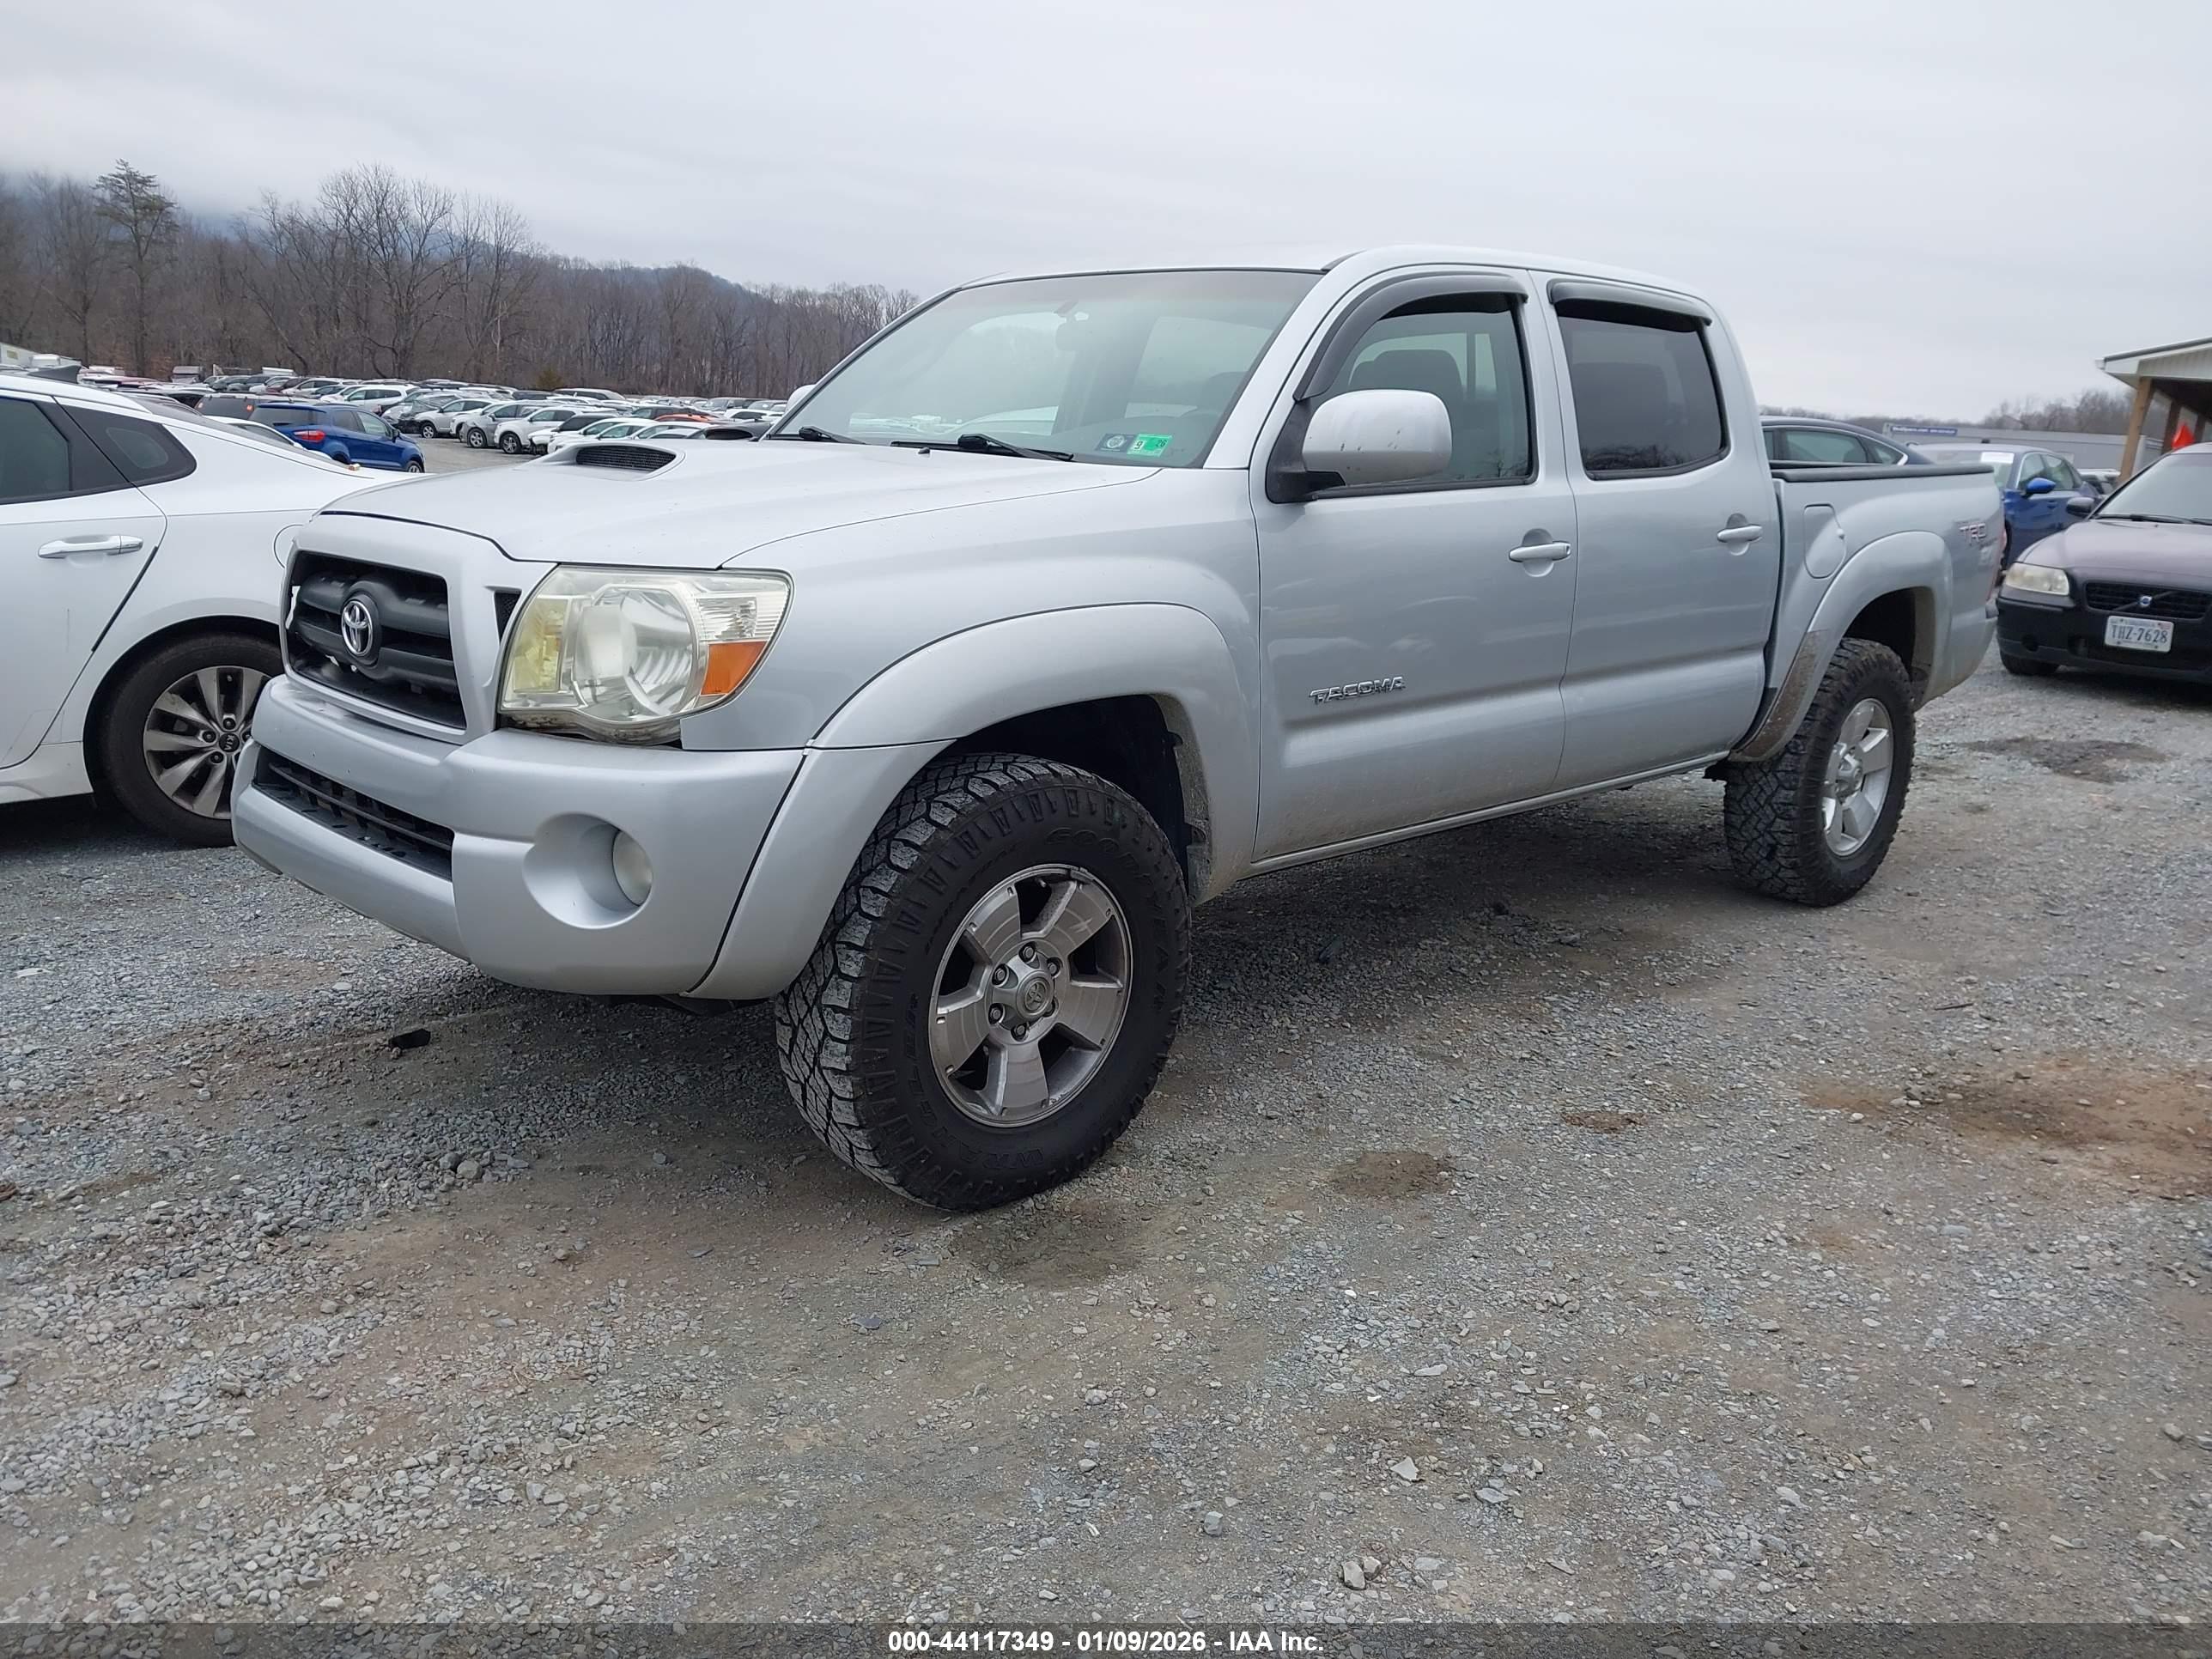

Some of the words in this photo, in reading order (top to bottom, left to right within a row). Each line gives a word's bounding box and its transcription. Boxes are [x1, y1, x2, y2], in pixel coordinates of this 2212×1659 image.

[1959, 523, 1986, 543] TRD
[1310, 676, 1405, 704] TACOMA
[224, 734, 235, 750] KIA
